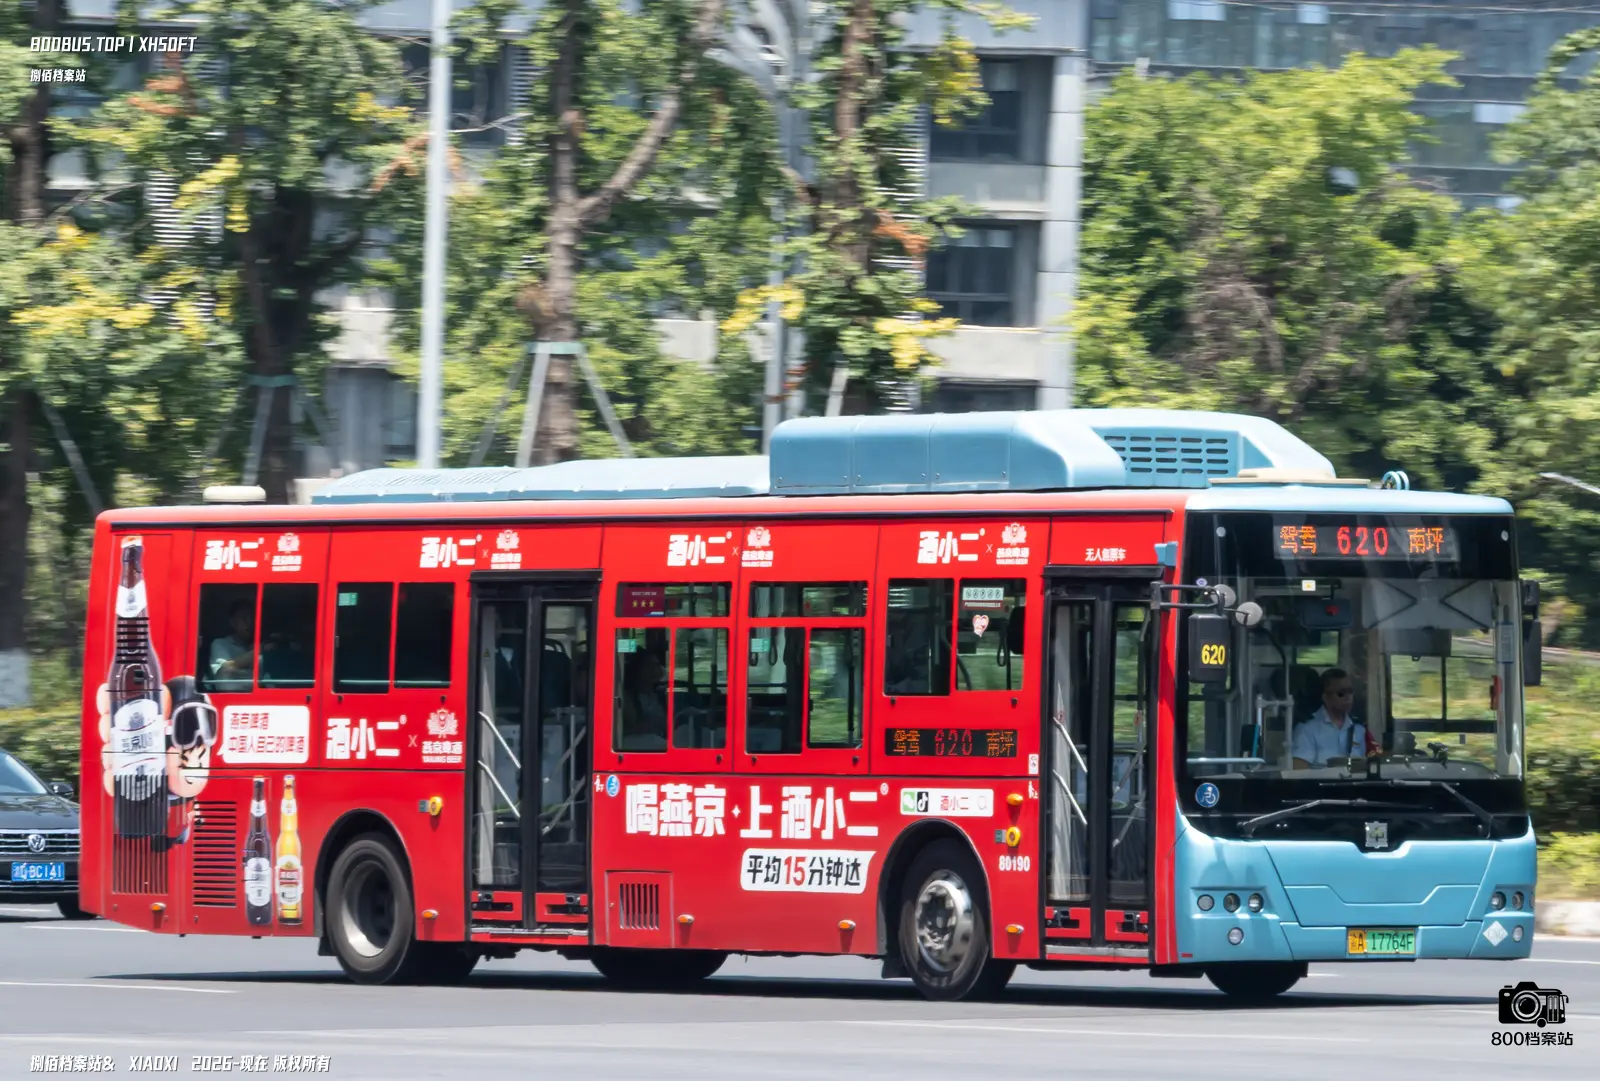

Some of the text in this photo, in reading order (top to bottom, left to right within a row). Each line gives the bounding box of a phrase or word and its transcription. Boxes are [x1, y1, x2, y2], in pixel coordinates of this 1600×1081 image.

[1337, 526, 1388, 555] 620
[1407, 526, 1444, 554] 南坪
[1201, 644, 1226, 665] 620
[326, 718, 400, 760] 酒小二
[935, 730, 972, 755] 620
[986, 730, 1015, 756] 南坪
[747, 855, 861, 886] 平均15分钟达
[999, 855, 1030, 872] 80190
[1371, 932, 1414, 950] 17764F
